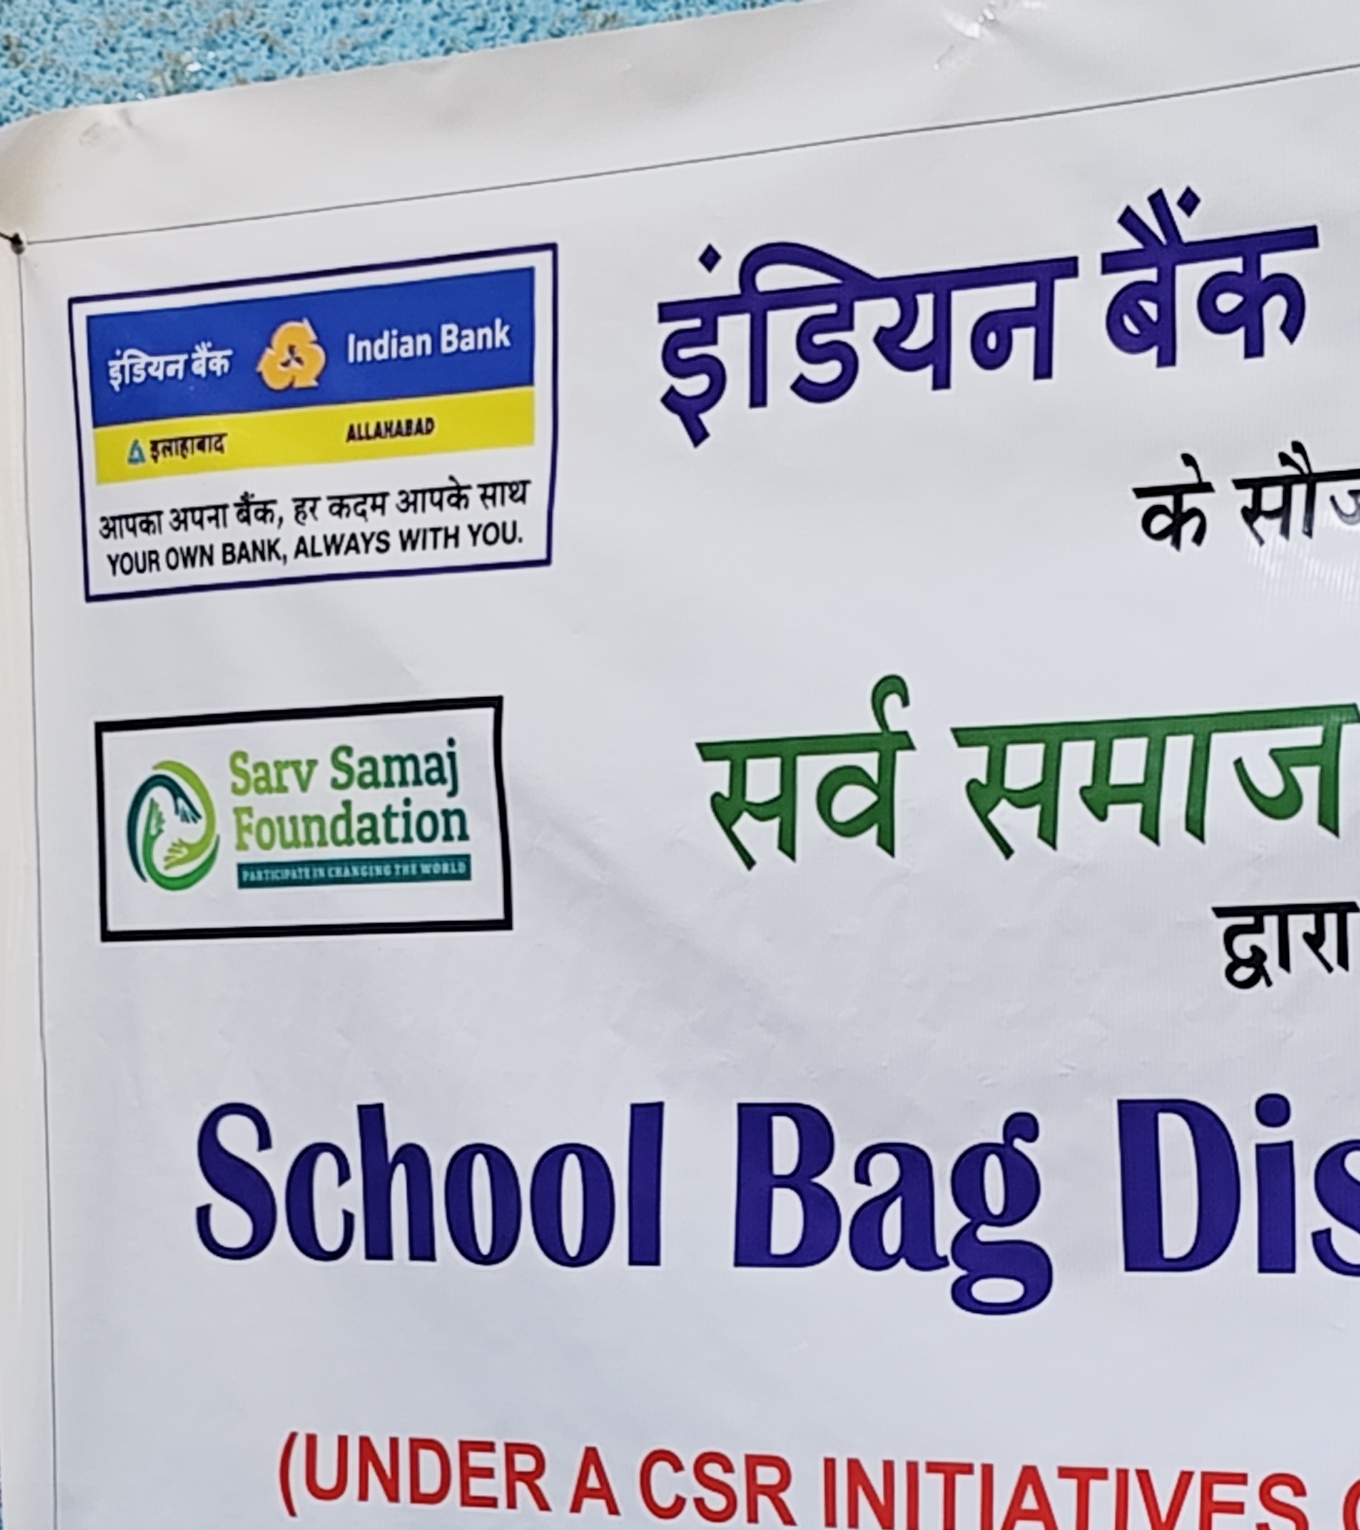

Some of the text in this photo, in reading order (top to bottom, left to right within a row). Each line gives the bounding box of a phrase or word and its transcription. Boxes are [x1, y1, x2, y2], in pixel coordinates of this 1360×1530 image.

[347, 317, 512, 364] Indian Bank
[656, 184, 1321, 450] इंडियन बैंक
[106, 340, 233, 392] इंडियन बैंक
[149, 431, 229, 464] इलाहाबाद
[344, 415, 437, 444] ALLAHABAD
[97, 474, 533, 541] आपका अपना बैंक, हर कदम आपके साथ
[1130, 451, 1217, 553] के
[105, 518, 524, 577] YOUR OWN BANK, ALWAYS WITH YOU.
[228, 736, 460, 798] Sarv Samaj
[693, 672, 918, 873] सर्व
[232, 796, 471, 852] Foundation
[194, 1099, 666, 1270] School
[731, 1101, 1055, 1317] Bag
[277, 1430, 554, 1518] (UNDER
[568, 1444, 622, 1518] A
[638, 1447, 799, 1528] CSR
